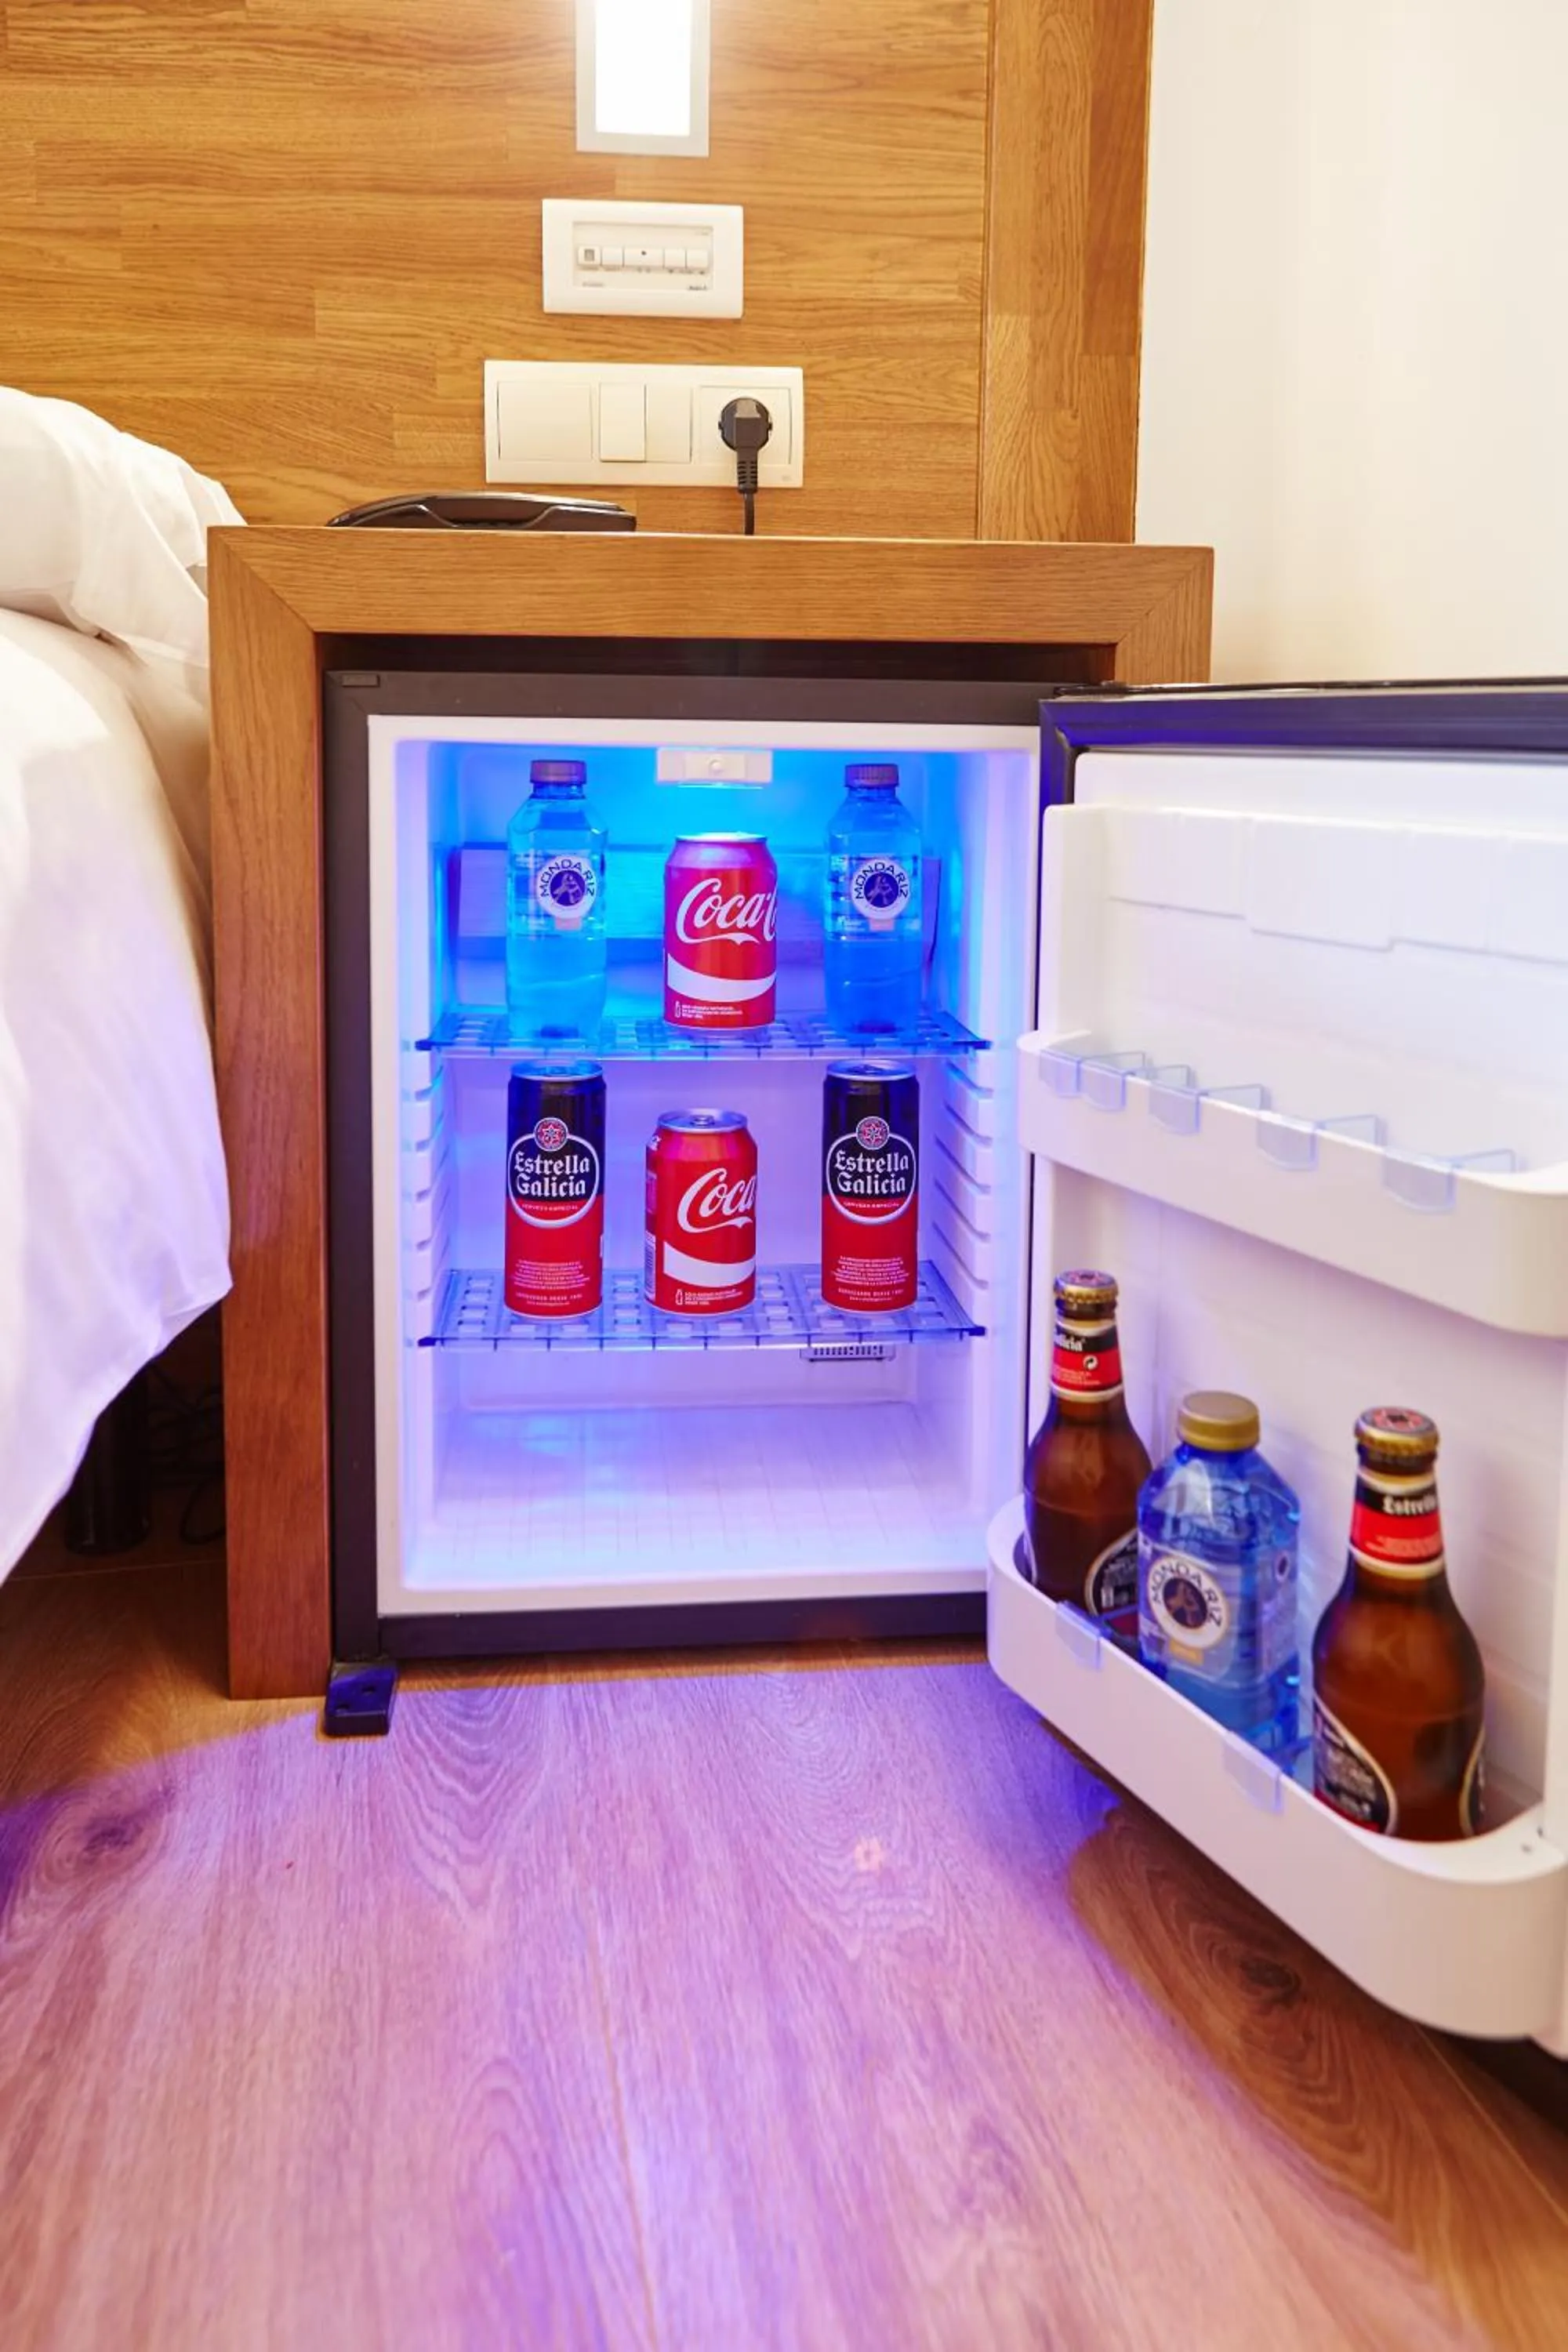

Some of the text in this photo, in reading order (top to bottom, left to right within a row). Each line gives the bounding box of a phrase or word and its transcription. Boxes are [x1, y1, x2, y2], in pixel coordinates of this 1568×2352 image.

[539, 858, 595, 898] MONDARIZ
[854, 862, 909, 899] MONDARIZ
[514, 1150, 590, 1175] Estrella
[834, 1149, 909, 1174] Estrella
[516, 1172, 586, 1197] Galicia
[837, 1171, 906, 1195] Galicia
[1150, 1560, 1222, 1628] MONDARIZ
